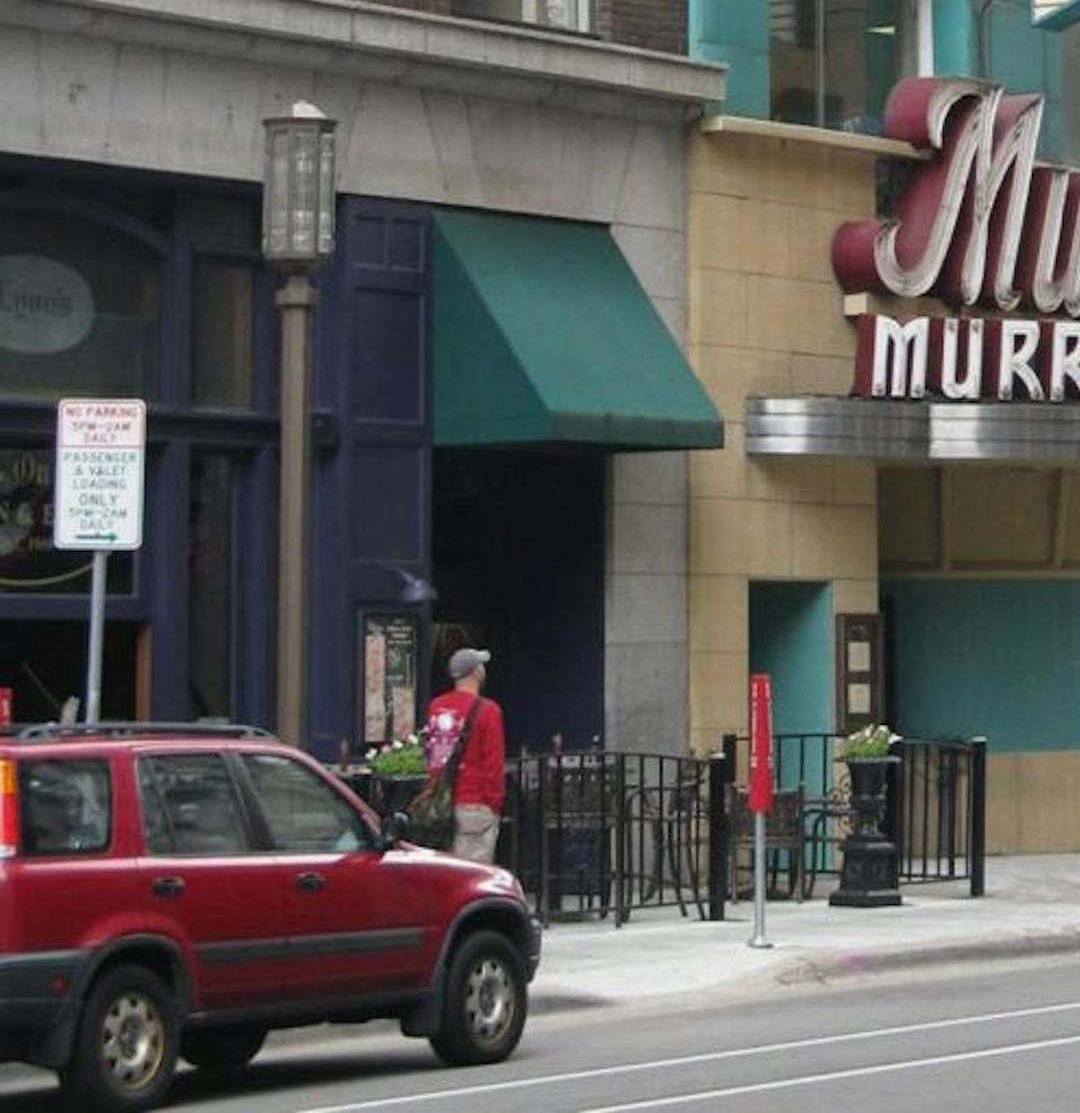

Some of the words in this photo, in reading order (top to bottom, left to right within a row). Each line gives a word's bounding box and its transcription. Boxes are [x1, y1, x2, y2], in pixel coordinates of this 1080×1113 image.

[65, 406, 83, 418] NO
[86, 406, 138, 418] PARKING
[84, 433, 117, 443] DAILY
[63, 452, 137, 463] PASSENGER
[89, 465, 126, 476] VALET
[72, 478, 127, 489] LOADING
[78, 493, 118, 506] ONLY
[79, 519, 114, 530] DAILY
